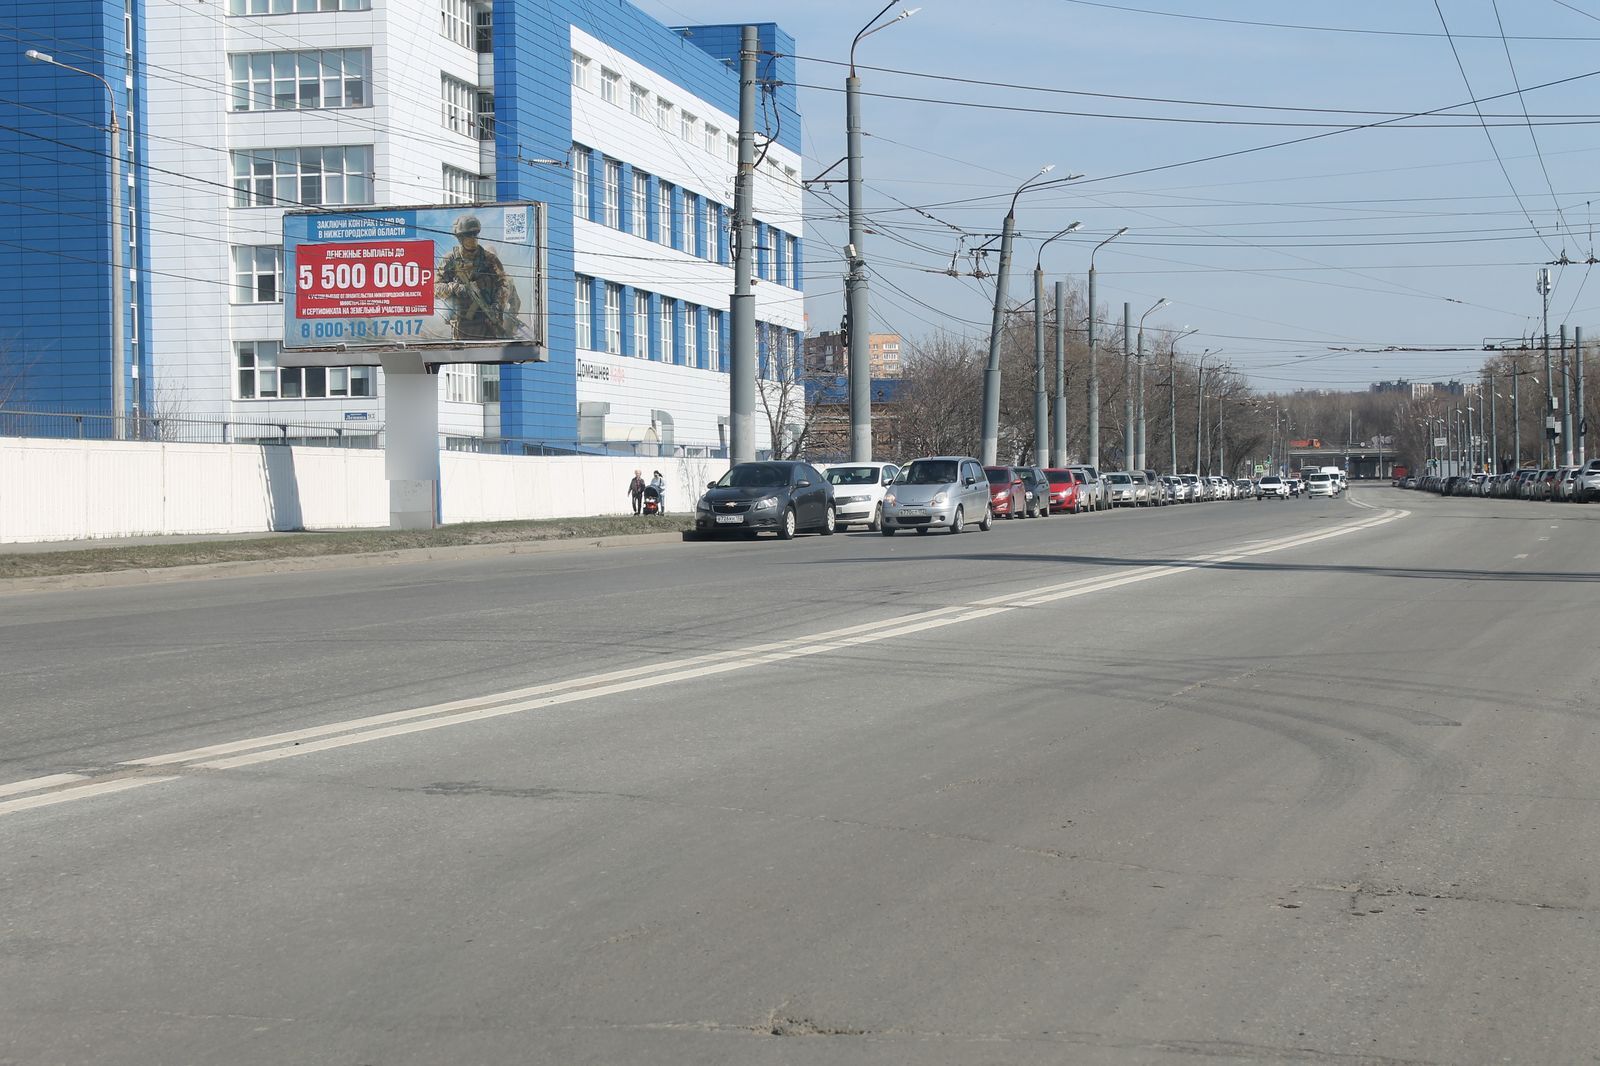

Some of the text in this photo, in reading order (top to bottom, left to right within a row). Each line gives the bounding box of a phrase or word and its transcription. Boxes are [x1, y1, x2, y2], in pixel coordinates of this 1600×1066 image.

[317, 220, 347, 229] ЗАКЛЮЧИ
[348, 218, 378, 228] КОНТРАКТ
[395, 217, 405, 226] РФ
[318, 227, 405, 239] В НИЖЕГОРОДСКОЙ ОБЛАСТИ
[326, 247, 405, 260] ДЕНЕЖНЫЕ ВЫПЛАТЫ ДО
[299, 265, 313, 290] 5
[321, 263, 366, 289] 500
[307, 307, 341, 316] СЕРТИФИКАТА
[342, 307, 349, 315] НА
[350, 305, 380, 315] ЗЕМЕЛЬНЫЙ
[381, 306, 404, 315] УЧАСТОК
[301, 320, 424, 338] 8 800-10-17-017
[576, 358, 609, 382] Домашнее
